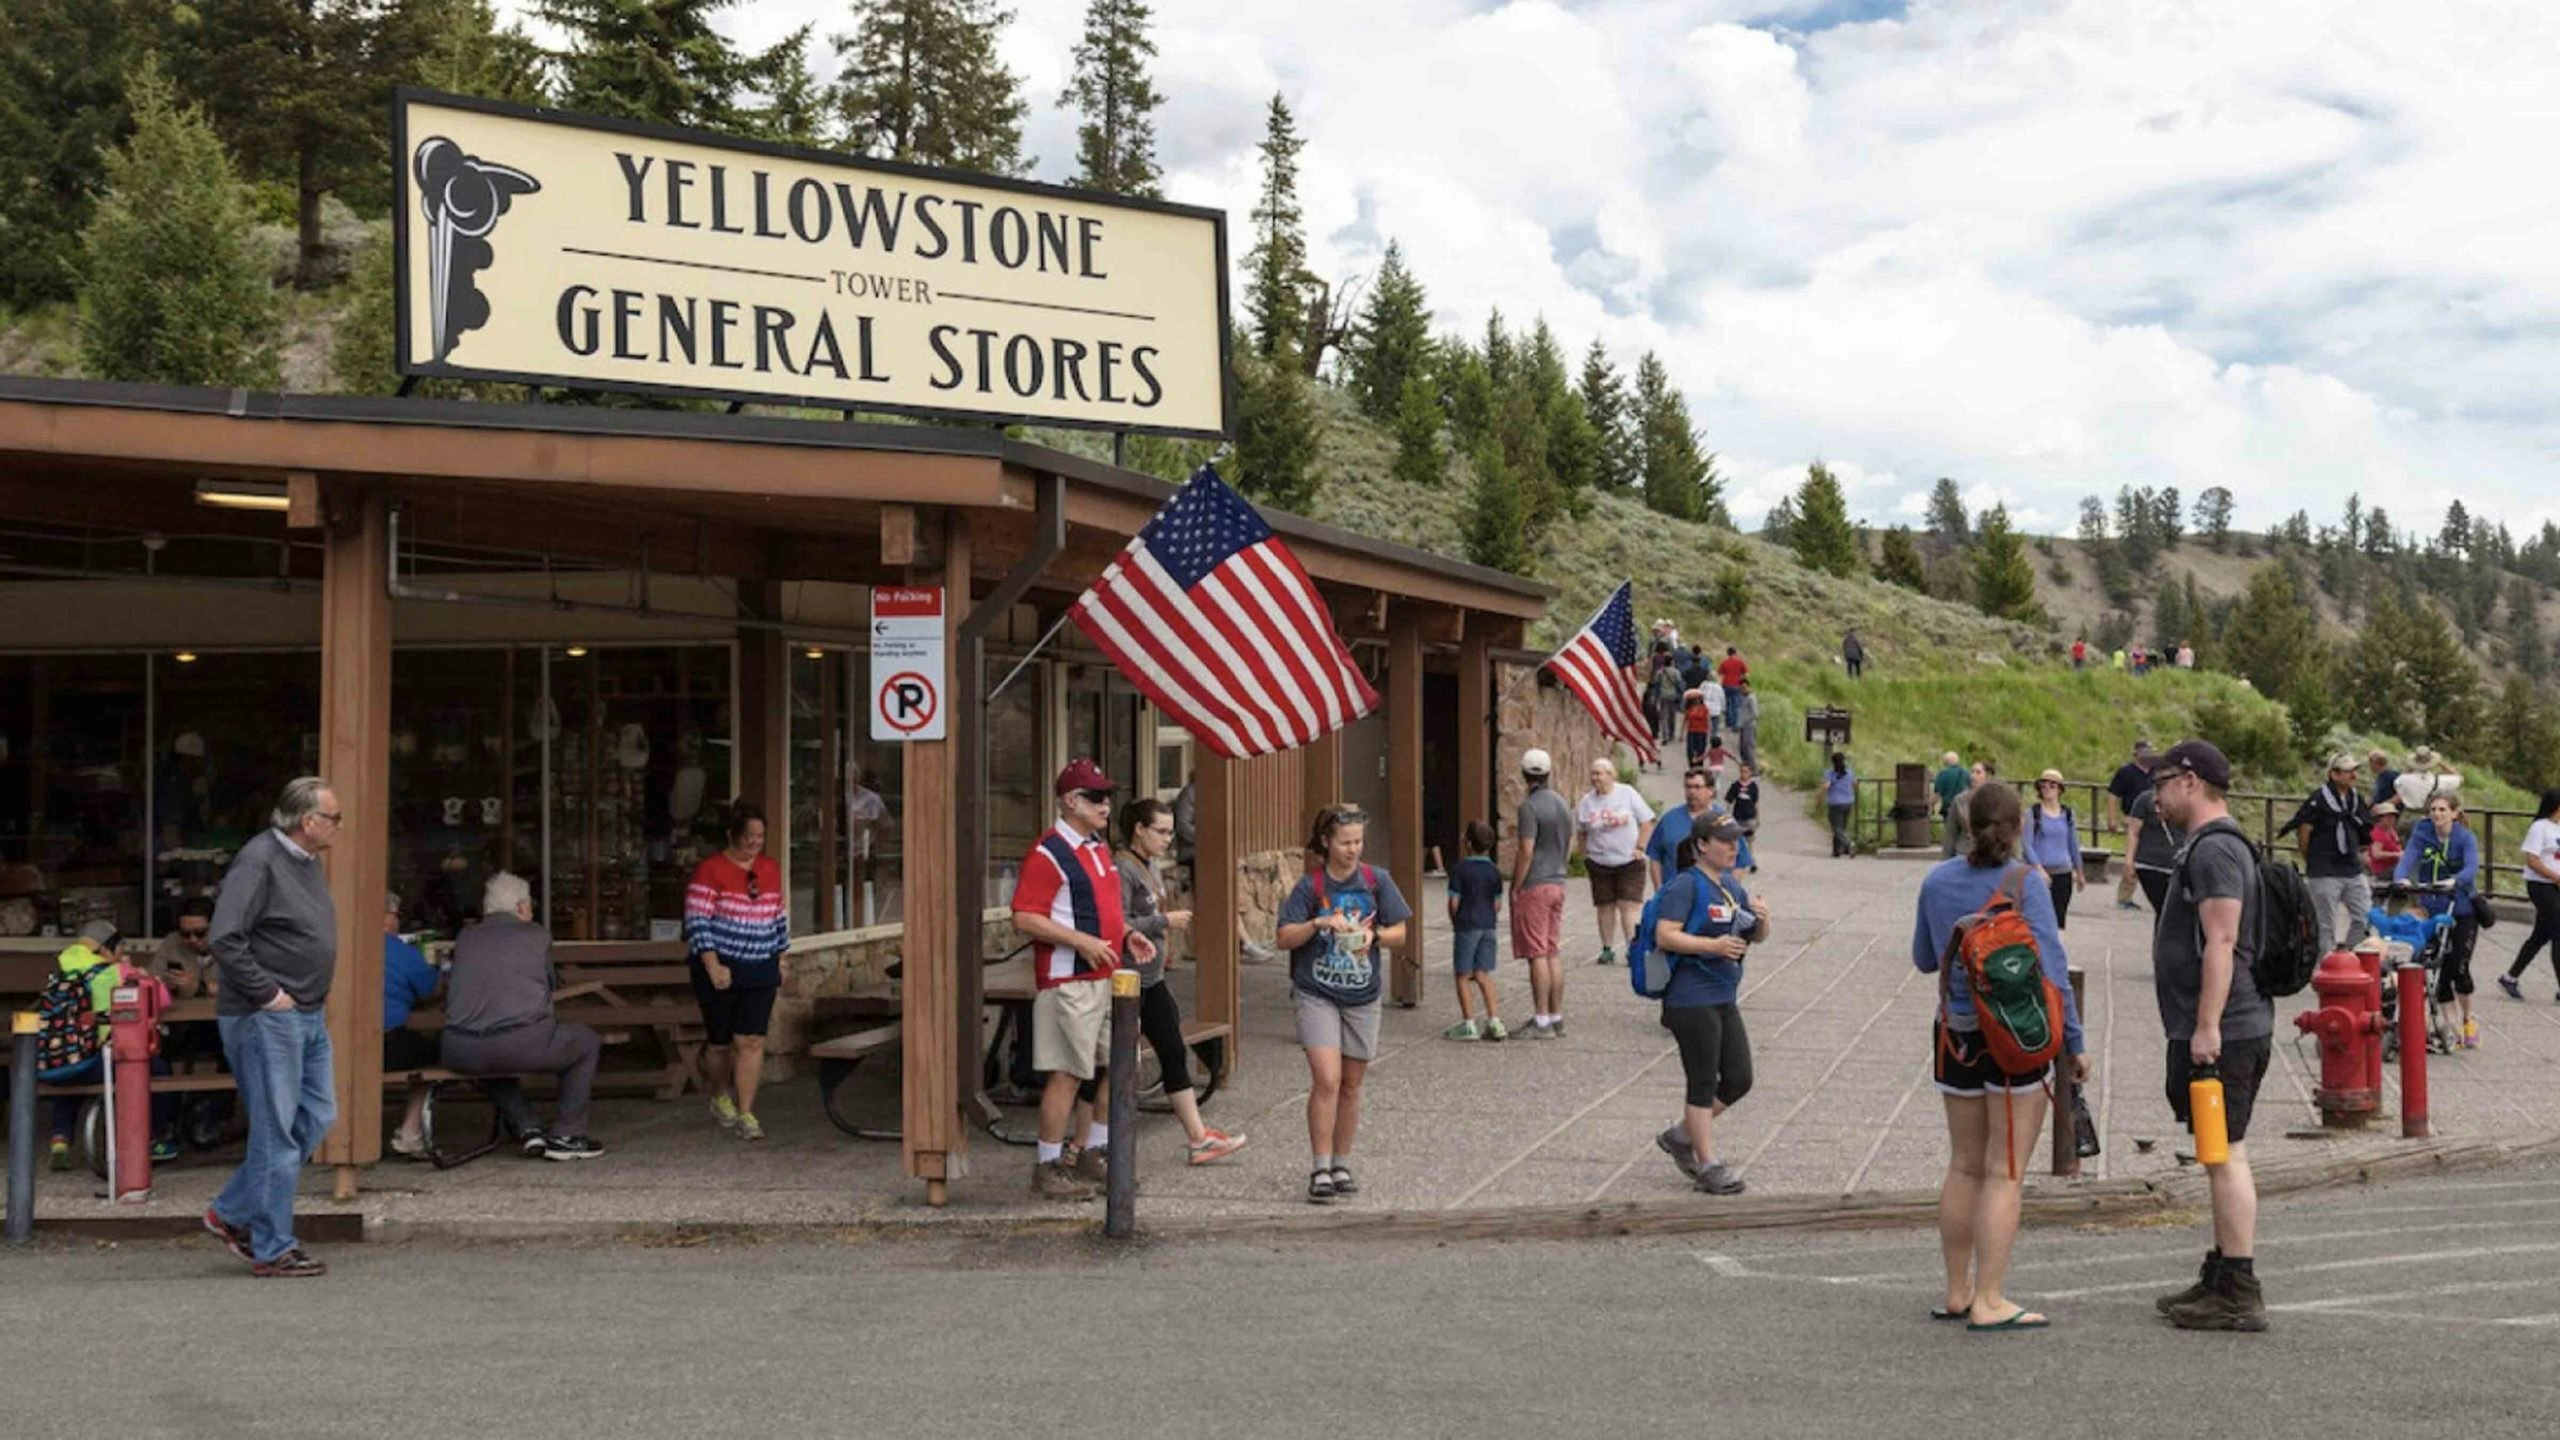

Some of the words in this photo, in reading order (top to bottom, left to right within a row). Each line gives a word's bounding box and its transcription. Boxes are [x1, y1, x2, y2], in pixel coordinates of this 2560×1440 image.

[614, 152, 1107, 279] YELLOWSTONE
[830, 269, 932, 305] TOWER
[556, 284, 890, 383] GENERAL
[929, 325, 1162, 408] STORES
[893, 590, 932, 605] Parking
